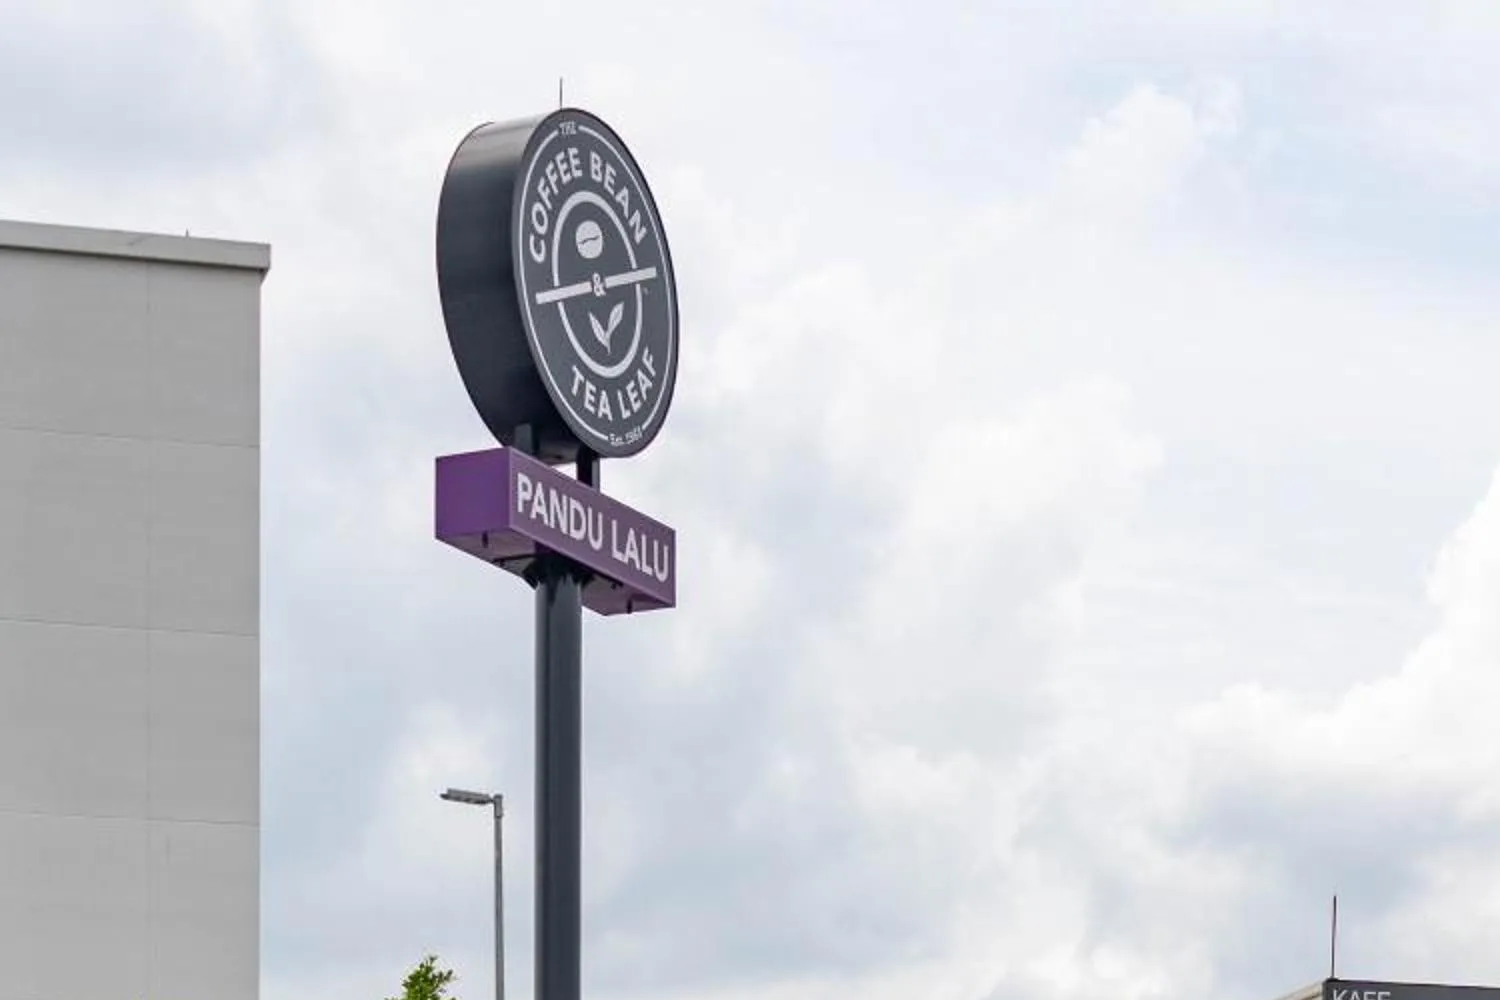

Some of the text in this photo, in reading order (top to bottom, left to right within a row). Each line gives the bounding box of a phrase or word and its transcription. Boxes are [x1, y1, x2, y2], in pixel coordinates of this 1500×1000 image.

[529, 147, 647, 263] COFFEE BEAN
[592, 271, 606, 297] &
[571, 346, 656, 421] TEA LEAF
[517, 472, 669, 582] PANDU LALU
